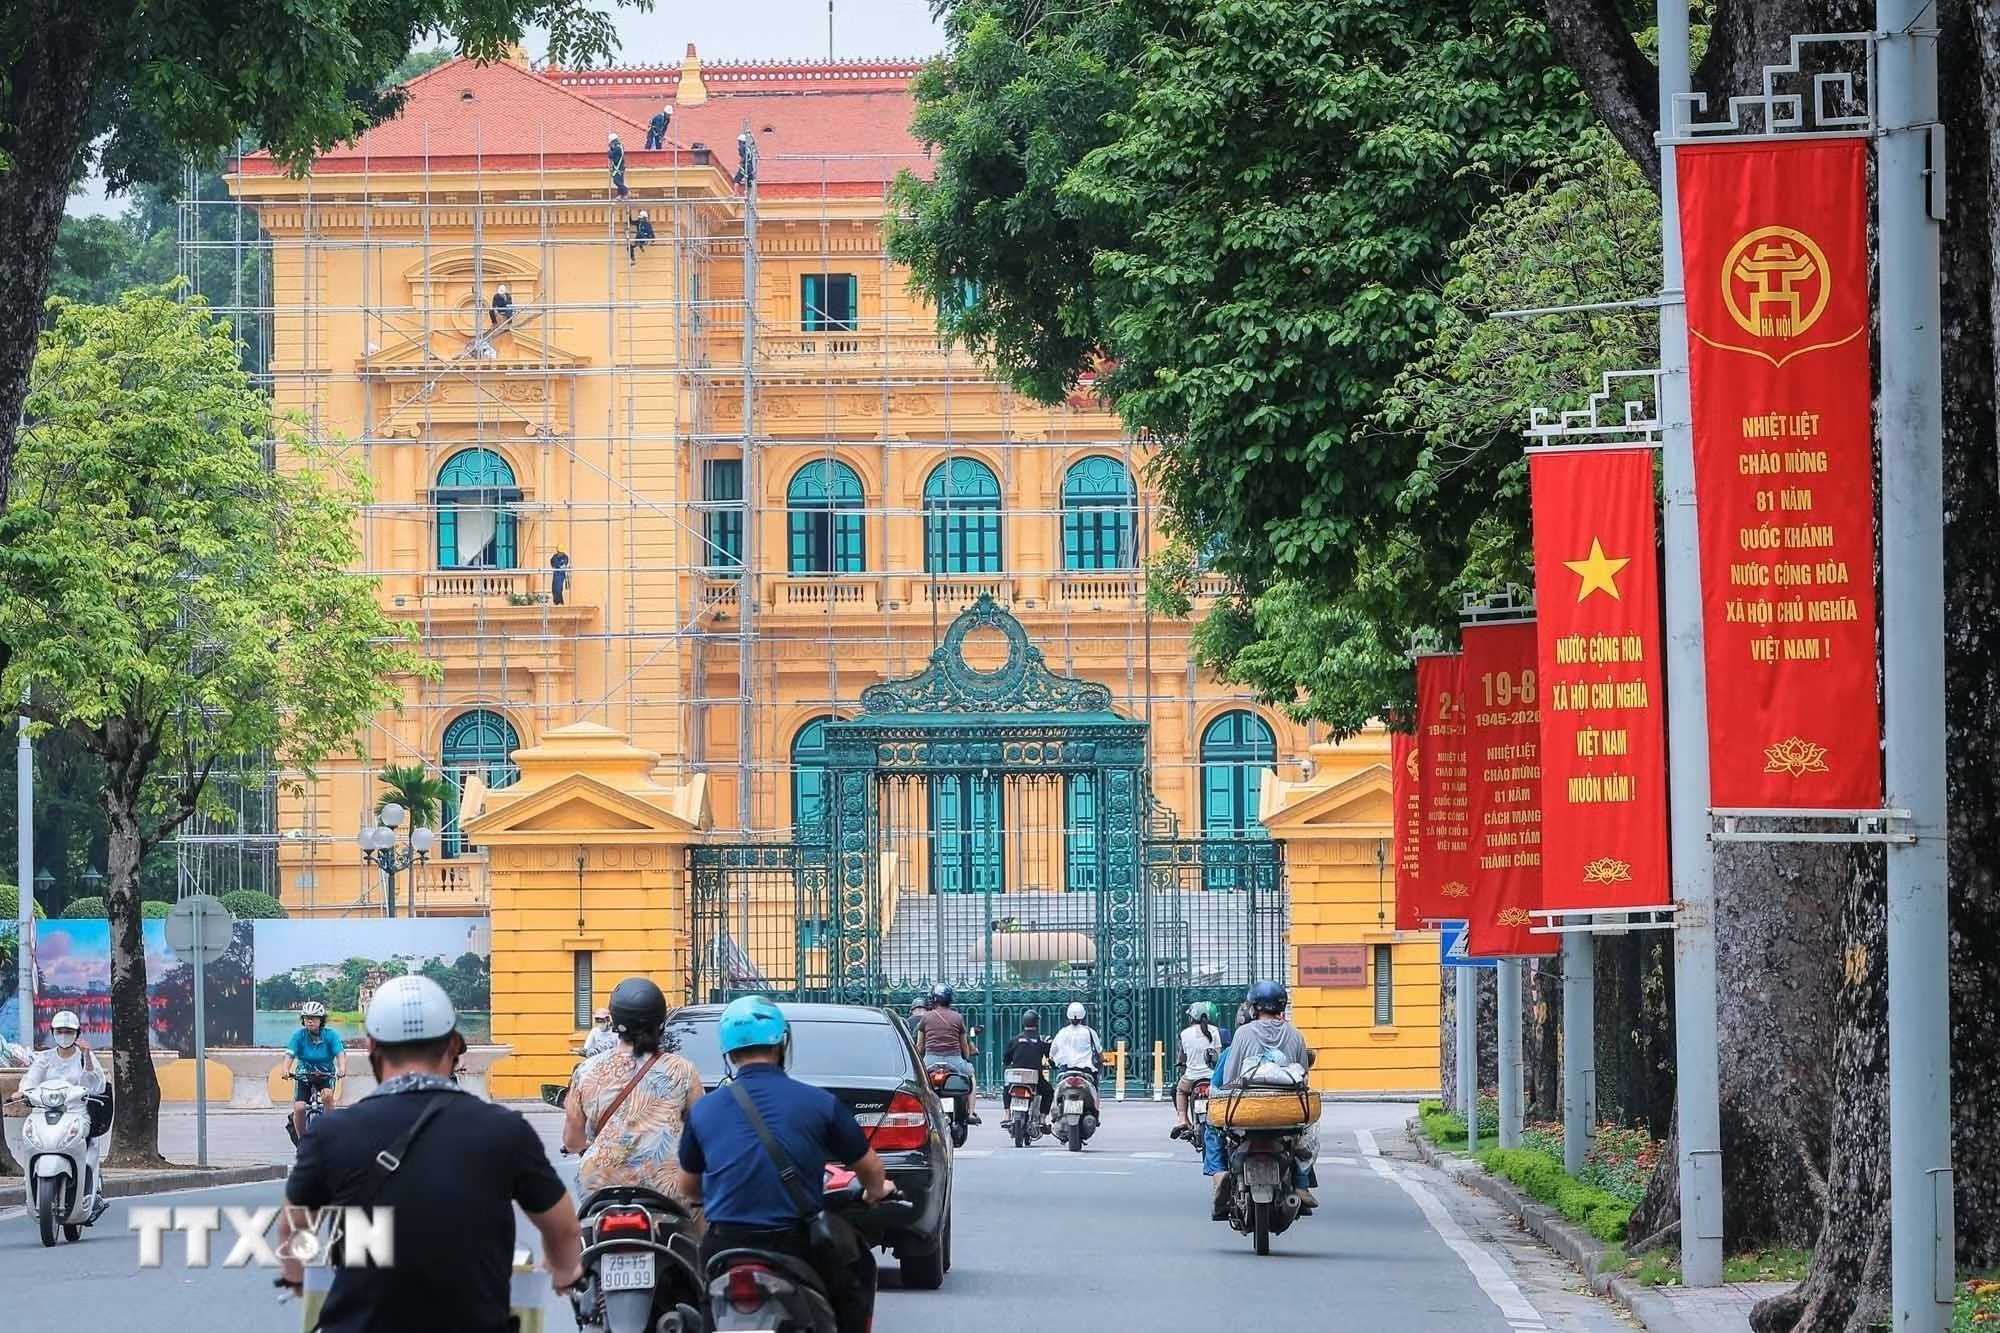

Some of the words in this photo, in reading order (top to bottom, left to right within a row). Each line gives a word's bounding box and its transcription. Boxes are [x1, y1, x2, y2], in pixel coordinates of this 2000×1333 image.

[1761, 314, 1774, 337] HÀ
[1776, 314, 1791, 341] NỘI
[1743, 412, 1786, 440] NHIỆT
[1790, 411, 1819, 440] LIỆT
[1739, 449, 1780, 475] CHÀO
[1785, 448, 1827, 473] MỪNG
[1756, 491, 1774, 511] 81
[1781, 486, 1812, 510] NĂM
[1740, 521, 1780, 551] QUỐC
[1784, 523, 1833, 547] KHÁNH
[1731, 561, 1769, 586] NƯỚC
[1774, 561, 1811, 589] CỘNG
[1816, 559, 1848, 584] HÒA
[1726, 598, 1745, 623] XÃ
[1748, 598, 1773, 627] HỘI
[1778, 595, 1804, 623] CHỦ
[1808, 596, 1857, 622] NGHĨA
[1556, 632, 1587, 664] NƯỚC
[1589, 631, 1619, 668] CỘNG
[1622, 630, 1643, 662] HÒA
[1751, 635, 1780, 664] VIỆT
[1784, 639, 1819, 660] NAM
[1482, 670, 1535, 706] 19-8
[1553, 680, 1568, 711] XÃ
[1570, 679, 1588, 715] HỘI
[1592, 675, 1613, 709] CHỦ
[1616, 678, 1648, 708] NGHĨA
[1487, 744, 1515, 762] NHIỆT
[1517, 742, 1536, 760] LIỆT
[1577, 725, 1599, 761] VIỆT
[1602, 730, 1626, 755] NAM
[1483, 767, 1510, 782] CHÀO
[1512, 764, 1540, 780] MỪNG
[1494, 790, 1505, 803] 81
[1509, 786, 1530, 802] NĂM
[1568, 772, 1600, 803] MUÔN
[1604, 772, 1629, 802] NĂM
[1484, 810, 1509, 825] CÁCH
[1512, 809, 1541, 825] MẠNG
[1486, 832, 1517, 847] THÁNG
[1520, 829, 1540, 845] TÁM
[1480, 853, 1511, 869] THÀNH
[1514, 850, 1540, 866] CÔNG
[605, 1271, 650, 1287] 900.99
